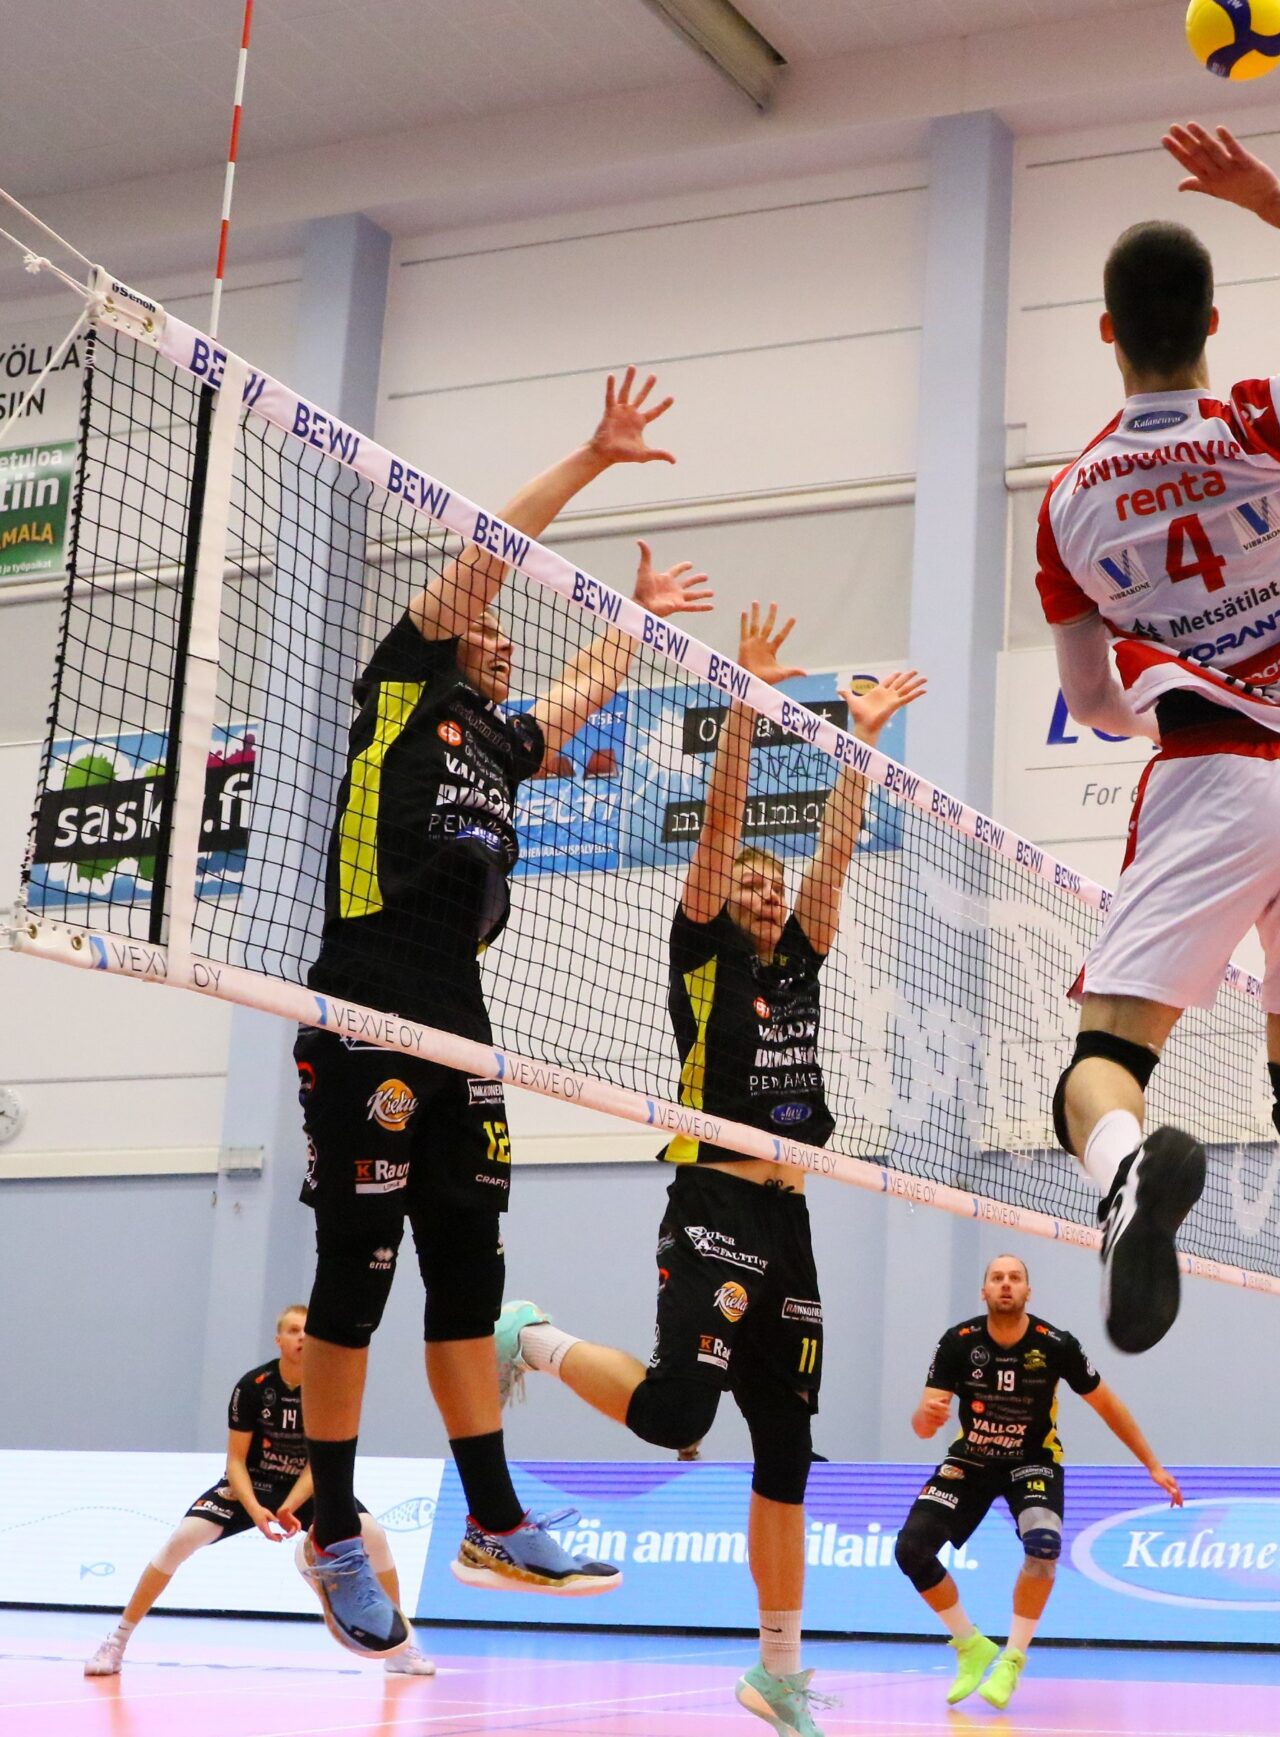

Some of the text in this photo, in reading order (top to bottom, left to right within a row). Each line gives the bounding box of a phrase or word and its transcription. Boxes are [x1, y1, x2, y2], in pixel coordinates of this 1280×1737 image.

[118, 284, 156, 313] Senoh
[292, 402, 360, 464] BEWI
[387, 459, 450, 519] BEWI
[1115, 470, 1227, 521] renta
[472, 512, 531, 567] BEWI
[1165, 513, 1228, 592] 4
[572, 571, 622, 622] BEWI
[642, 614, 689, 664] BEWI
[708, 654, 751, 700] BEWI
[781, 701, 821, 743] BEWI
[834, 735, 872, 774] BEWI
[884, 764, 920, 800] BEWI
[1082, 782, 1123, 806] For
[932, 789, 963, 825] BEWI
[975, 816, 1005, 850] BEWI
[1016, 840, 1044, 872] BEWI
[1054, 864, 1081, 894] BEWI
[193, 963, 222, 989] OY
[332, 1004, 424, 1052] VEXVE OY
[508, 1061, 557, 1093] VEXVE
[558, 1076, 585, 1102] OY
[366, 1091, 418, 1121] Kieku
[658, 1106, 721, 1140] VEXVE OY
[483, 1121, 511, 1163] 12
[782, 1144, 837, 1174] VEXVE OY
[475, 1174, 505, 1187] CRAFT
[890, 1176, 937, 1203] VEXVE OY
[980, 1205, 1021, 1227] VEXVE OY
[798, 1338, 817, 1374] 11
[997, 1370, 1015, 1391] 19
[282, 1409, 297, 1430] 14
[973, 1418, 1027, 1436] VALLOX
[928, 1486, 959, 1505] Rauta
